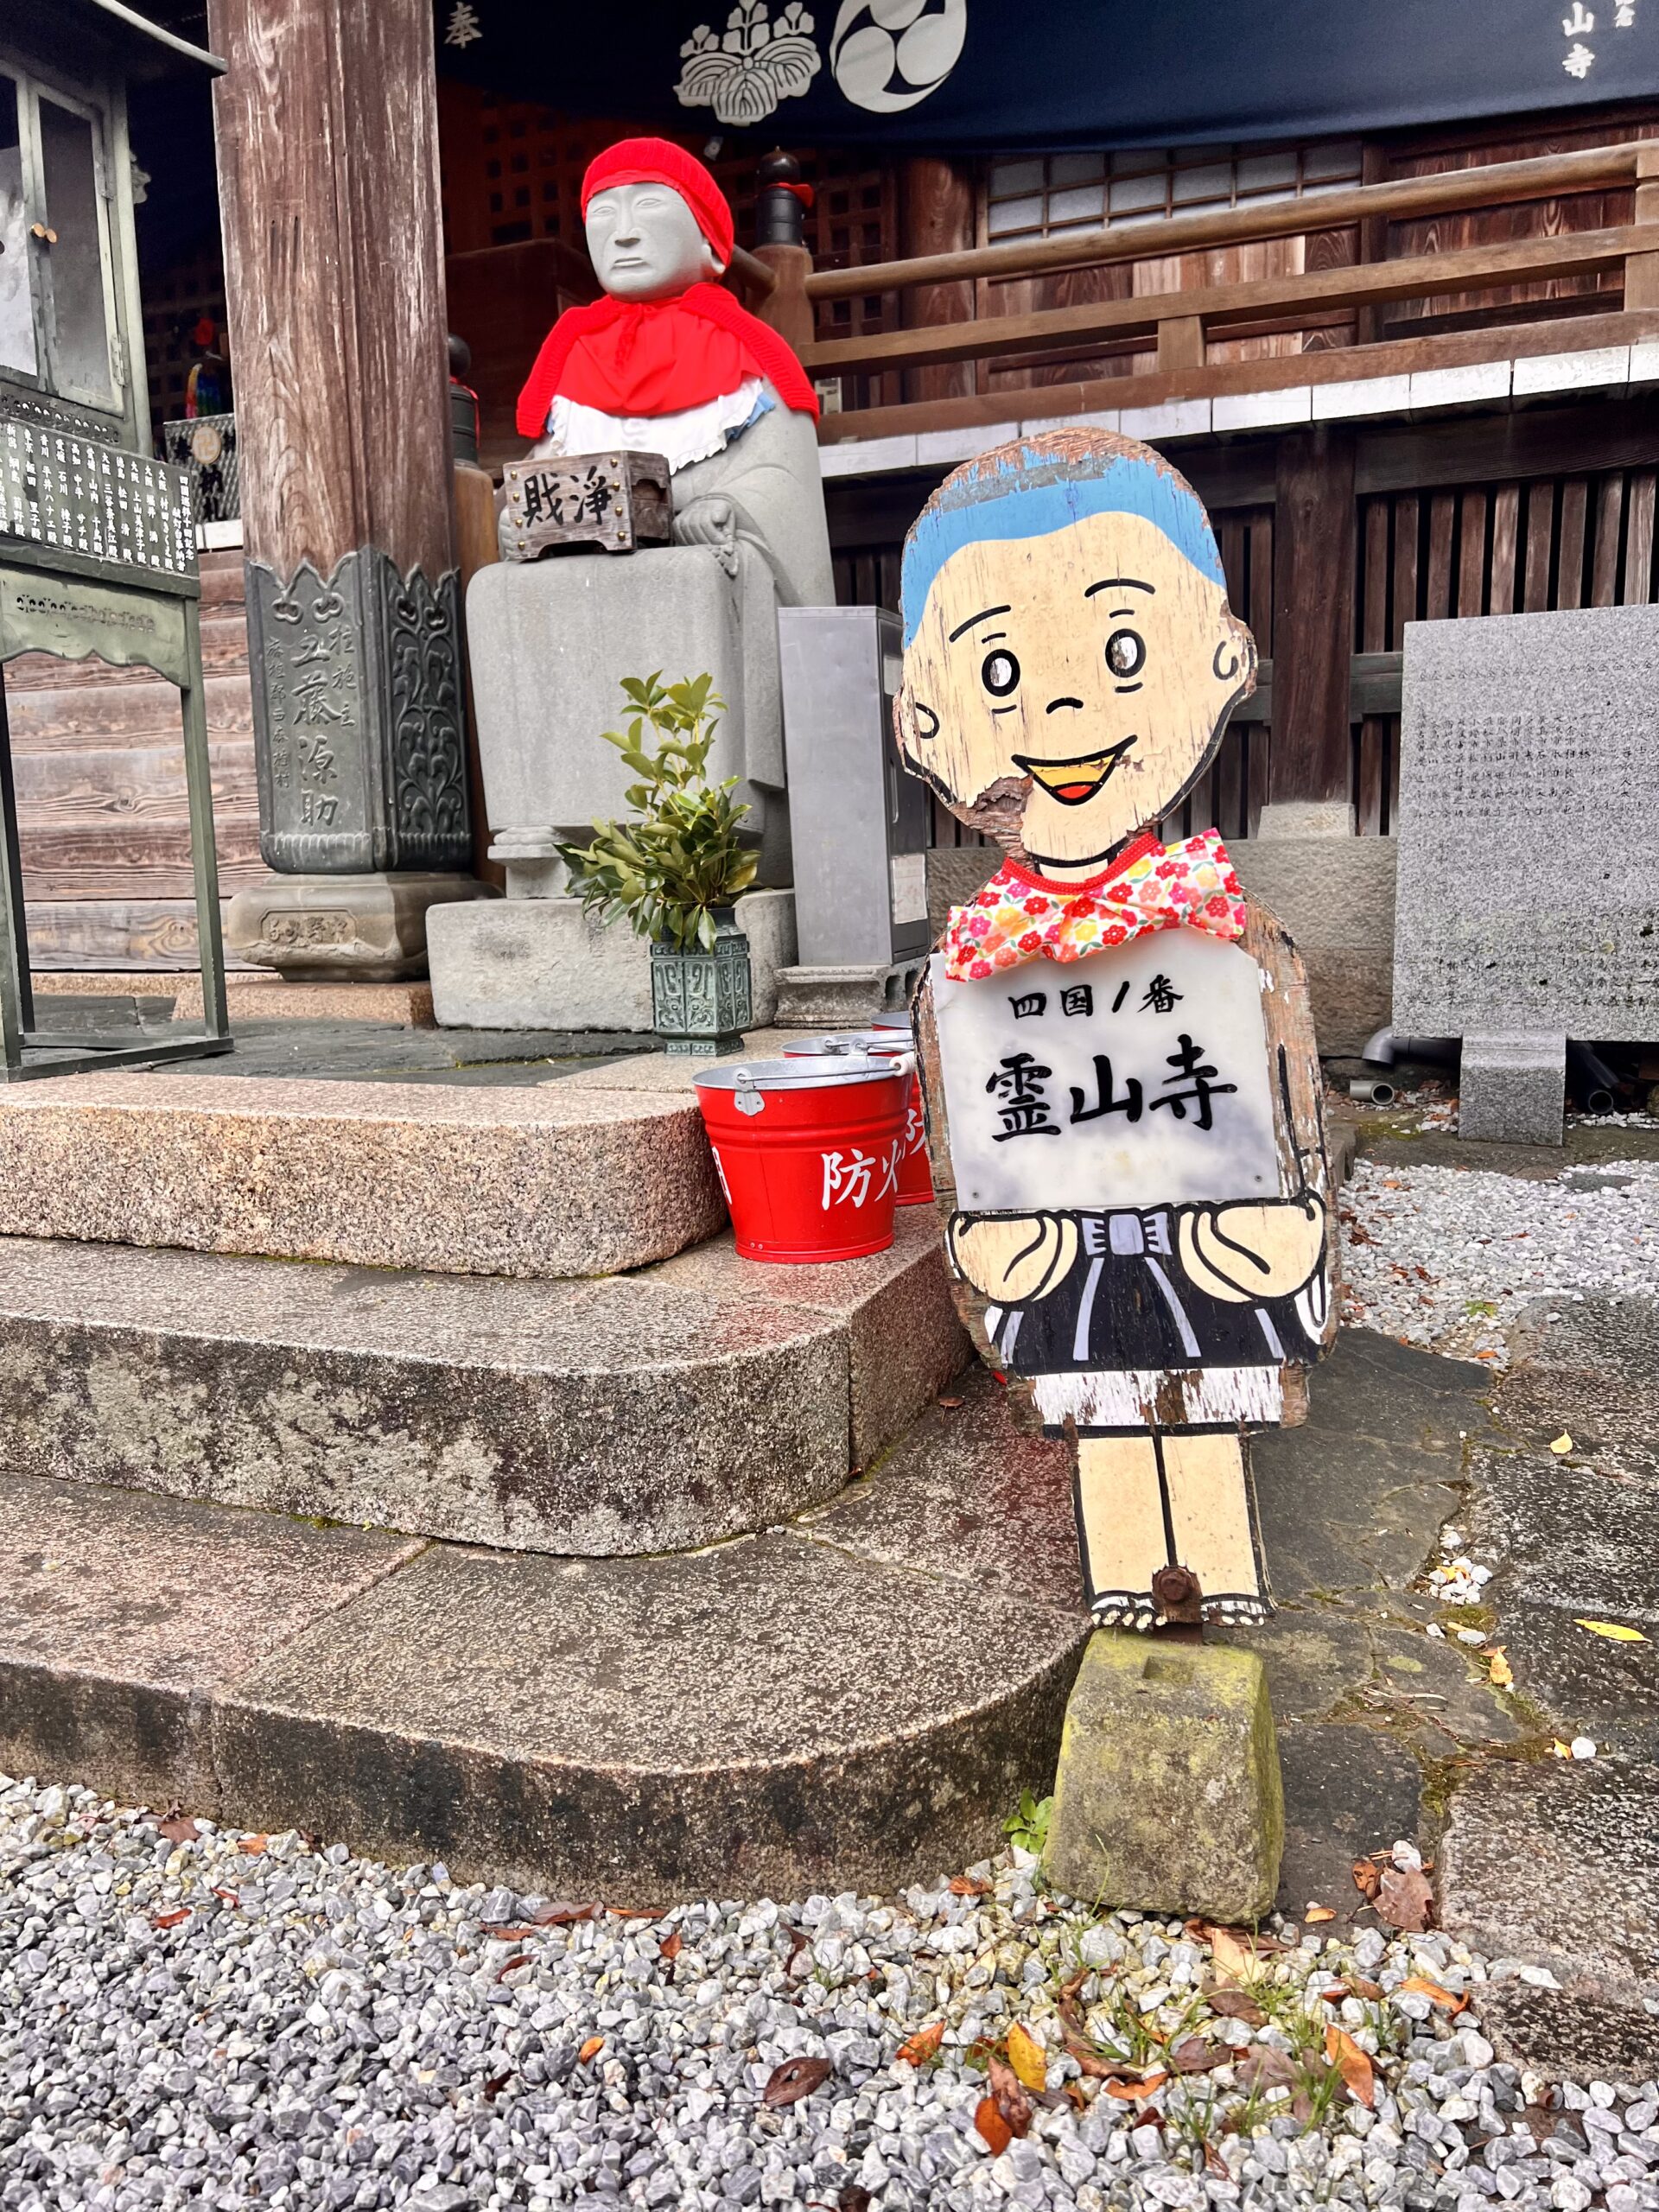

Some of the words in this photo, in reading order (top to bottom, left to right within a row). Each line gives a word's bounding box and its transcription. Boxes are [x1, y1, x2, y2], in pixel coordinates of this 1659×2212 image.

[444, 1, 483, 50] 奉
[1562, 2, 1595, 79] 山寺
[24, 429, 34, 454] 東京
[40, 434, 49, 459] 香川
[101, 452, 111, 475] 大阪
[130, 461, 140, 483] 大阪
[145, 465, 154, 487] 大阪
[59, 471, 68, 496] 石川
[73, 474, 84, 499] 中平
[89, 479, 99, 504] 山内
[158, 469, 168, 492] 大阪
[985, 1033, 1238, 1142] 霊山寺
